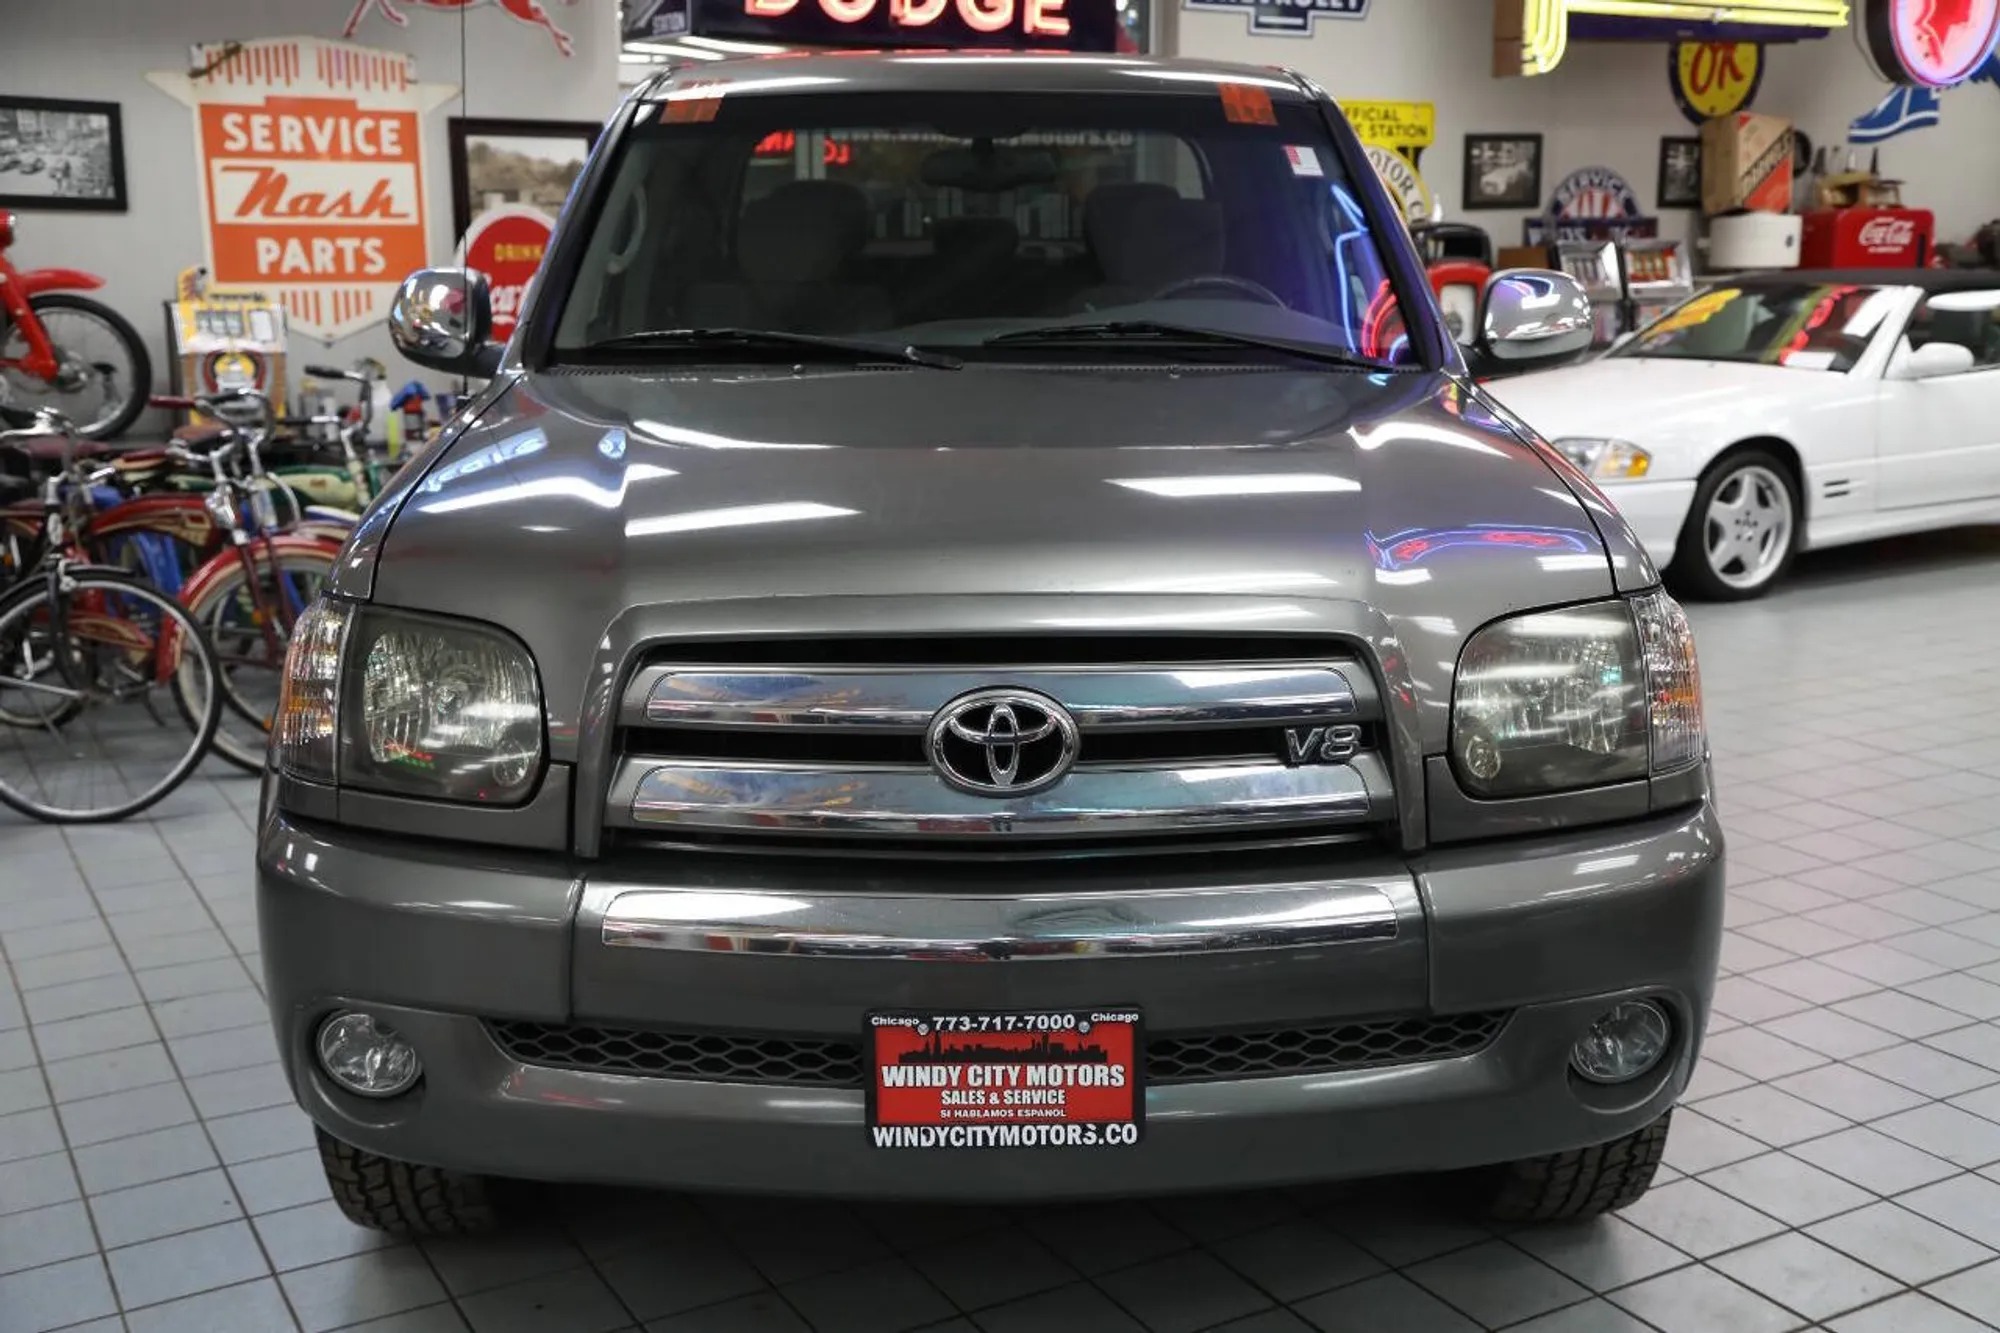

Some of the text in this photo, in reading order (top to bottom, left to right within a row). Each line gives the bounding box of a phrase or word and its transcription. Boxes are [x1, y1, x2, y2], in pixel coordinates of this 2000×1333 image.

[1344, 107, 1401, 122] FFICIAL
[222, 113, 403, 155] SERVICE
[1369, 123, 1428, 138] STATION
[1369, 150, 1414, 196] OTOR
[221, 166, 409, 217] Nash
[256, 237, 386, 274] PARTS
[1285, 724, 1361, 762] V8
[871, 1012, 1139, 1031] Chicago 773-717-7000 Chicago
[881, 1063, 1125, 1087] WINDY CITY MOTORS
[941, 1089, 1065, 1105] SALES & SERVICE
[940, 1109, 951, 1118] SI
[954, 1109, 1014, 1118] HABLAMOS
[872, 1123, 1138, 1148] WINDYCITYMOTORS.CO
